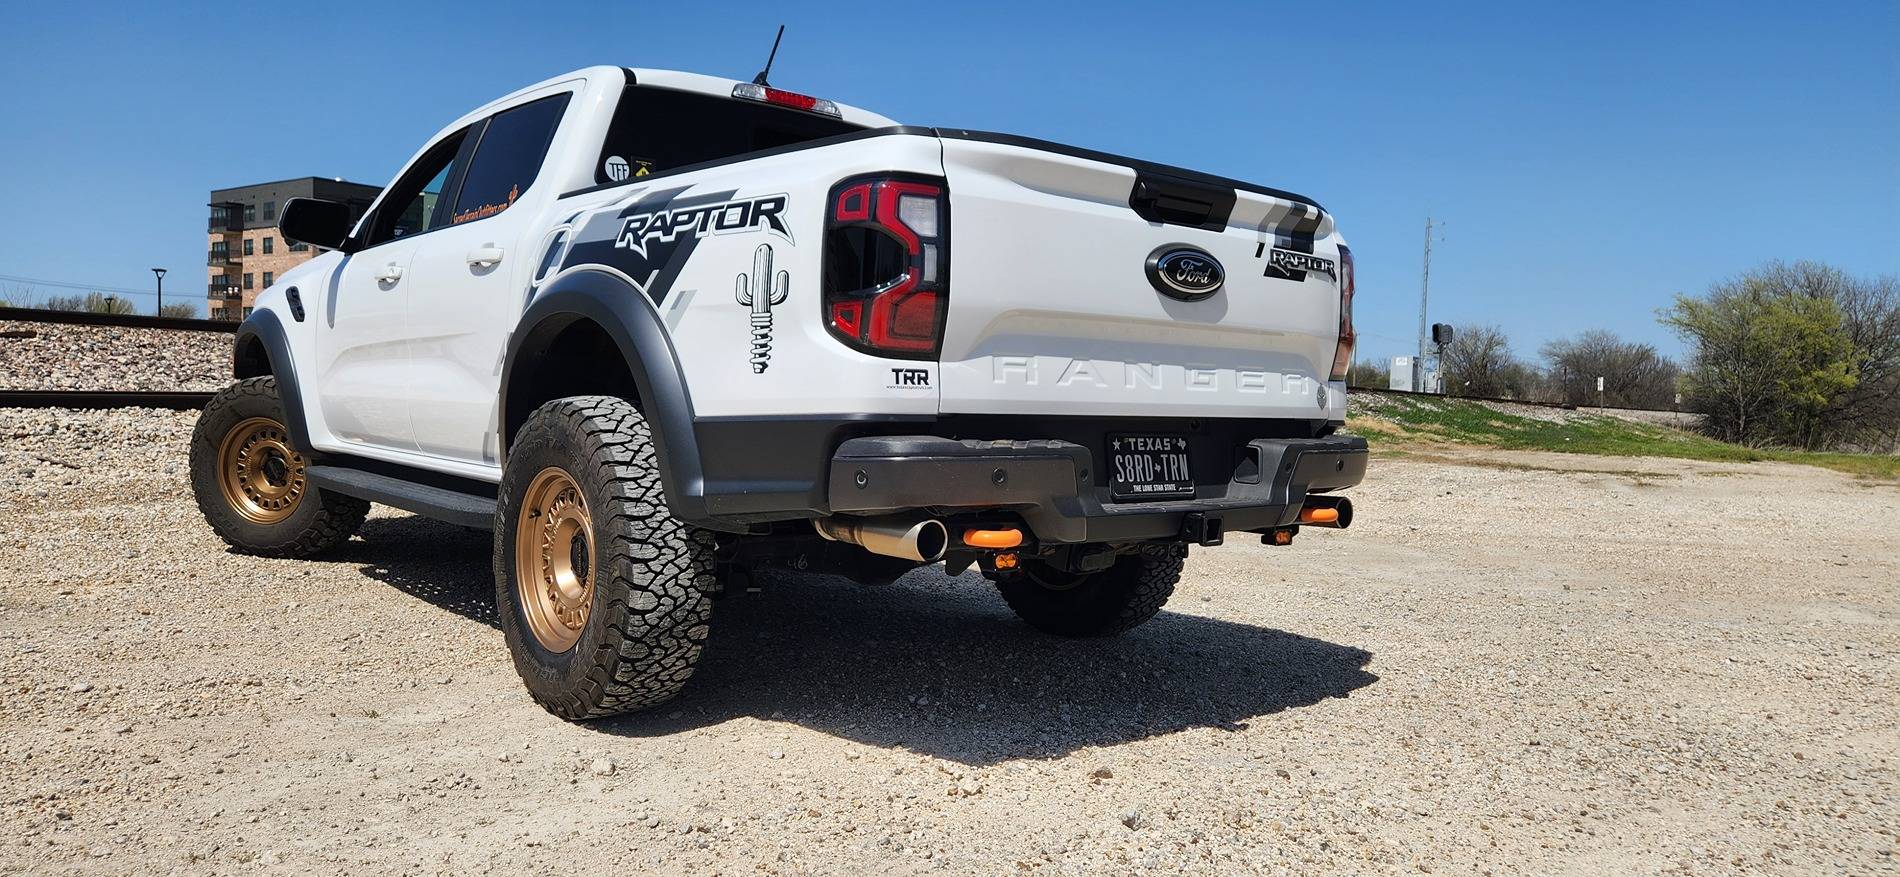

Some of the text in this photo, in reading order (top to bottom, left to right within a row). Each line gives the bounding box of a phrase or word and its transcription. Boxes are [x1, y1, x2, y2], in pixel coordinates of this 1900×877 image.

[615, 193, 795, 259] RAPTOR
[1175, 258, 1211, 284] Ford
[1270, 249, 1337, 282] RAPTOR
[891, 368, 929, 386] TRR
[992, 355, 1309, 395] RANGER
[1128, 438, 1171, 451] TEXAS
[1115, 454, 1189, 482] S8RD TRN
[1133, 484, 1142, 492] THE
[1142, 484, 1153, 492] LONE
[1164, 483, 1177, 491] STATE
